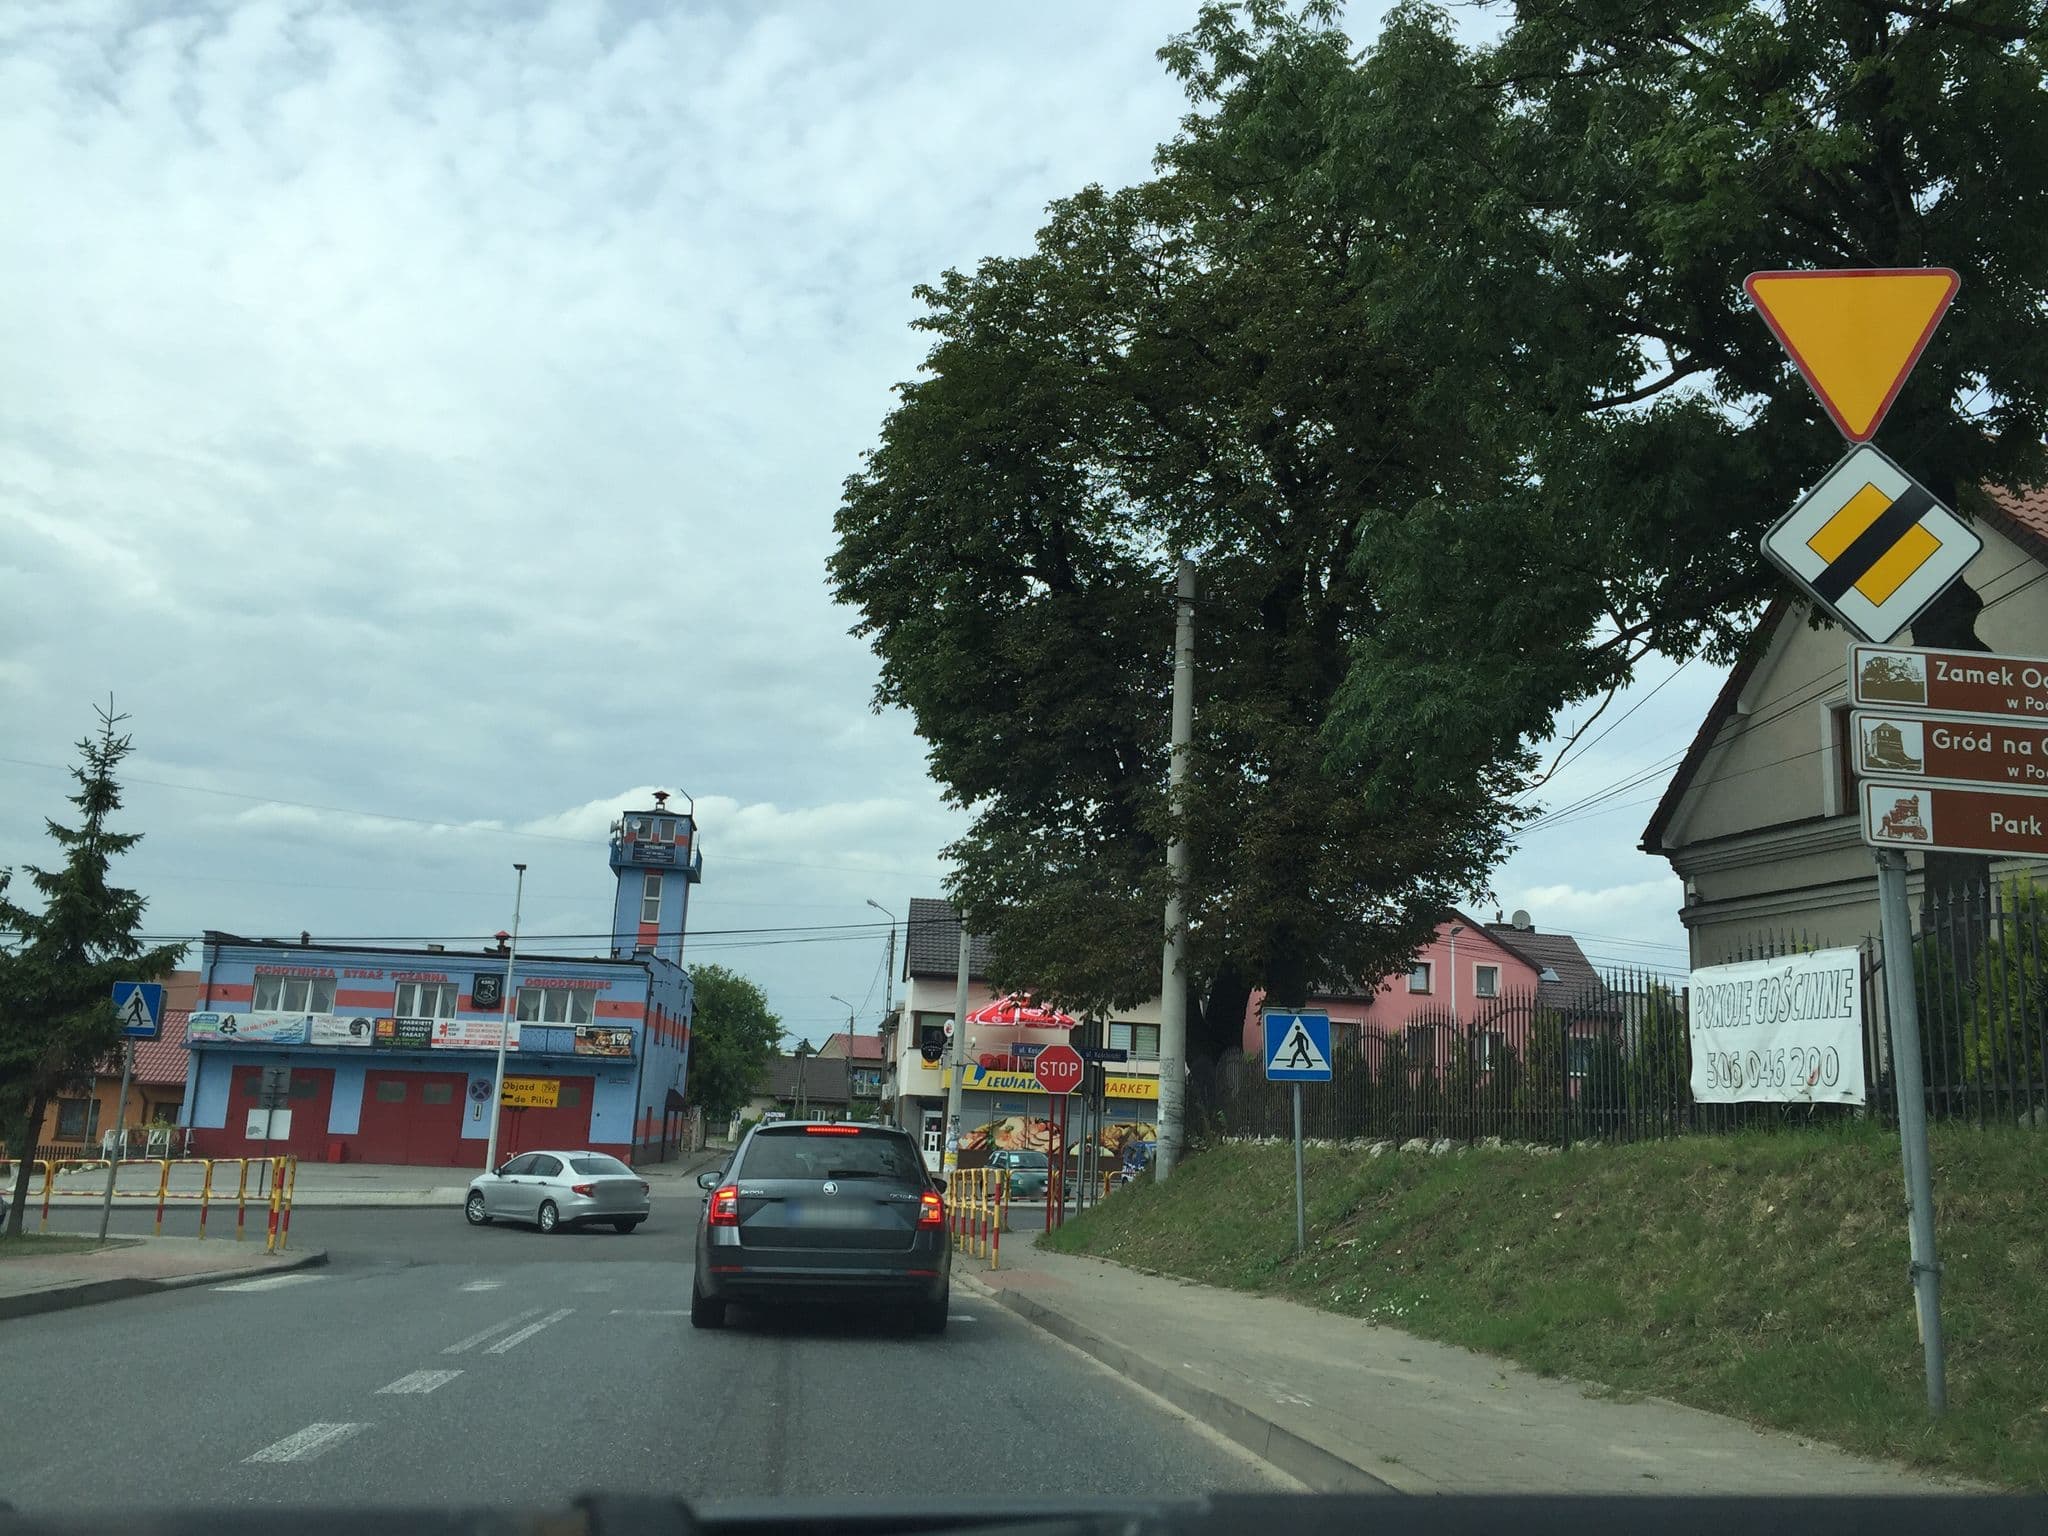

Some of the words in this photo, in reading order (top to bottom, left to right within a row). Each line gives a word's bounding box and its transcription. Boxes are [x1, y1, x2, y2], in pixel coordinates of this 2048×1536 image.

[1936, 660, 2014, 687] Zamek
[2007, 698, 2019, 710] w
[1932, 728, 1992, 753] Gród
[2003, 739, 2032, 756] na
[2007, 766, 2019, 777] w
[2026, 764, 2048, 780] Po
[1990, 812, 2043, 836] Park
[1695, 980, 1753, 1030] POKOJE
[1755, 965, 1854, 1024] GOŚCINNE
[1039, 1061, 1078, 1076] STOP
[1706, 1050, 1743, 1089] 506
[1745, 1048, 1785, 1088] 046
[1789, 1045, 1840, 1087] 200
[502, 1080, 535, 1091] Objazd
[987, 1076, 1043, 1090] LEWIATA
[531, 1096, 554, 1105] Pilicy
